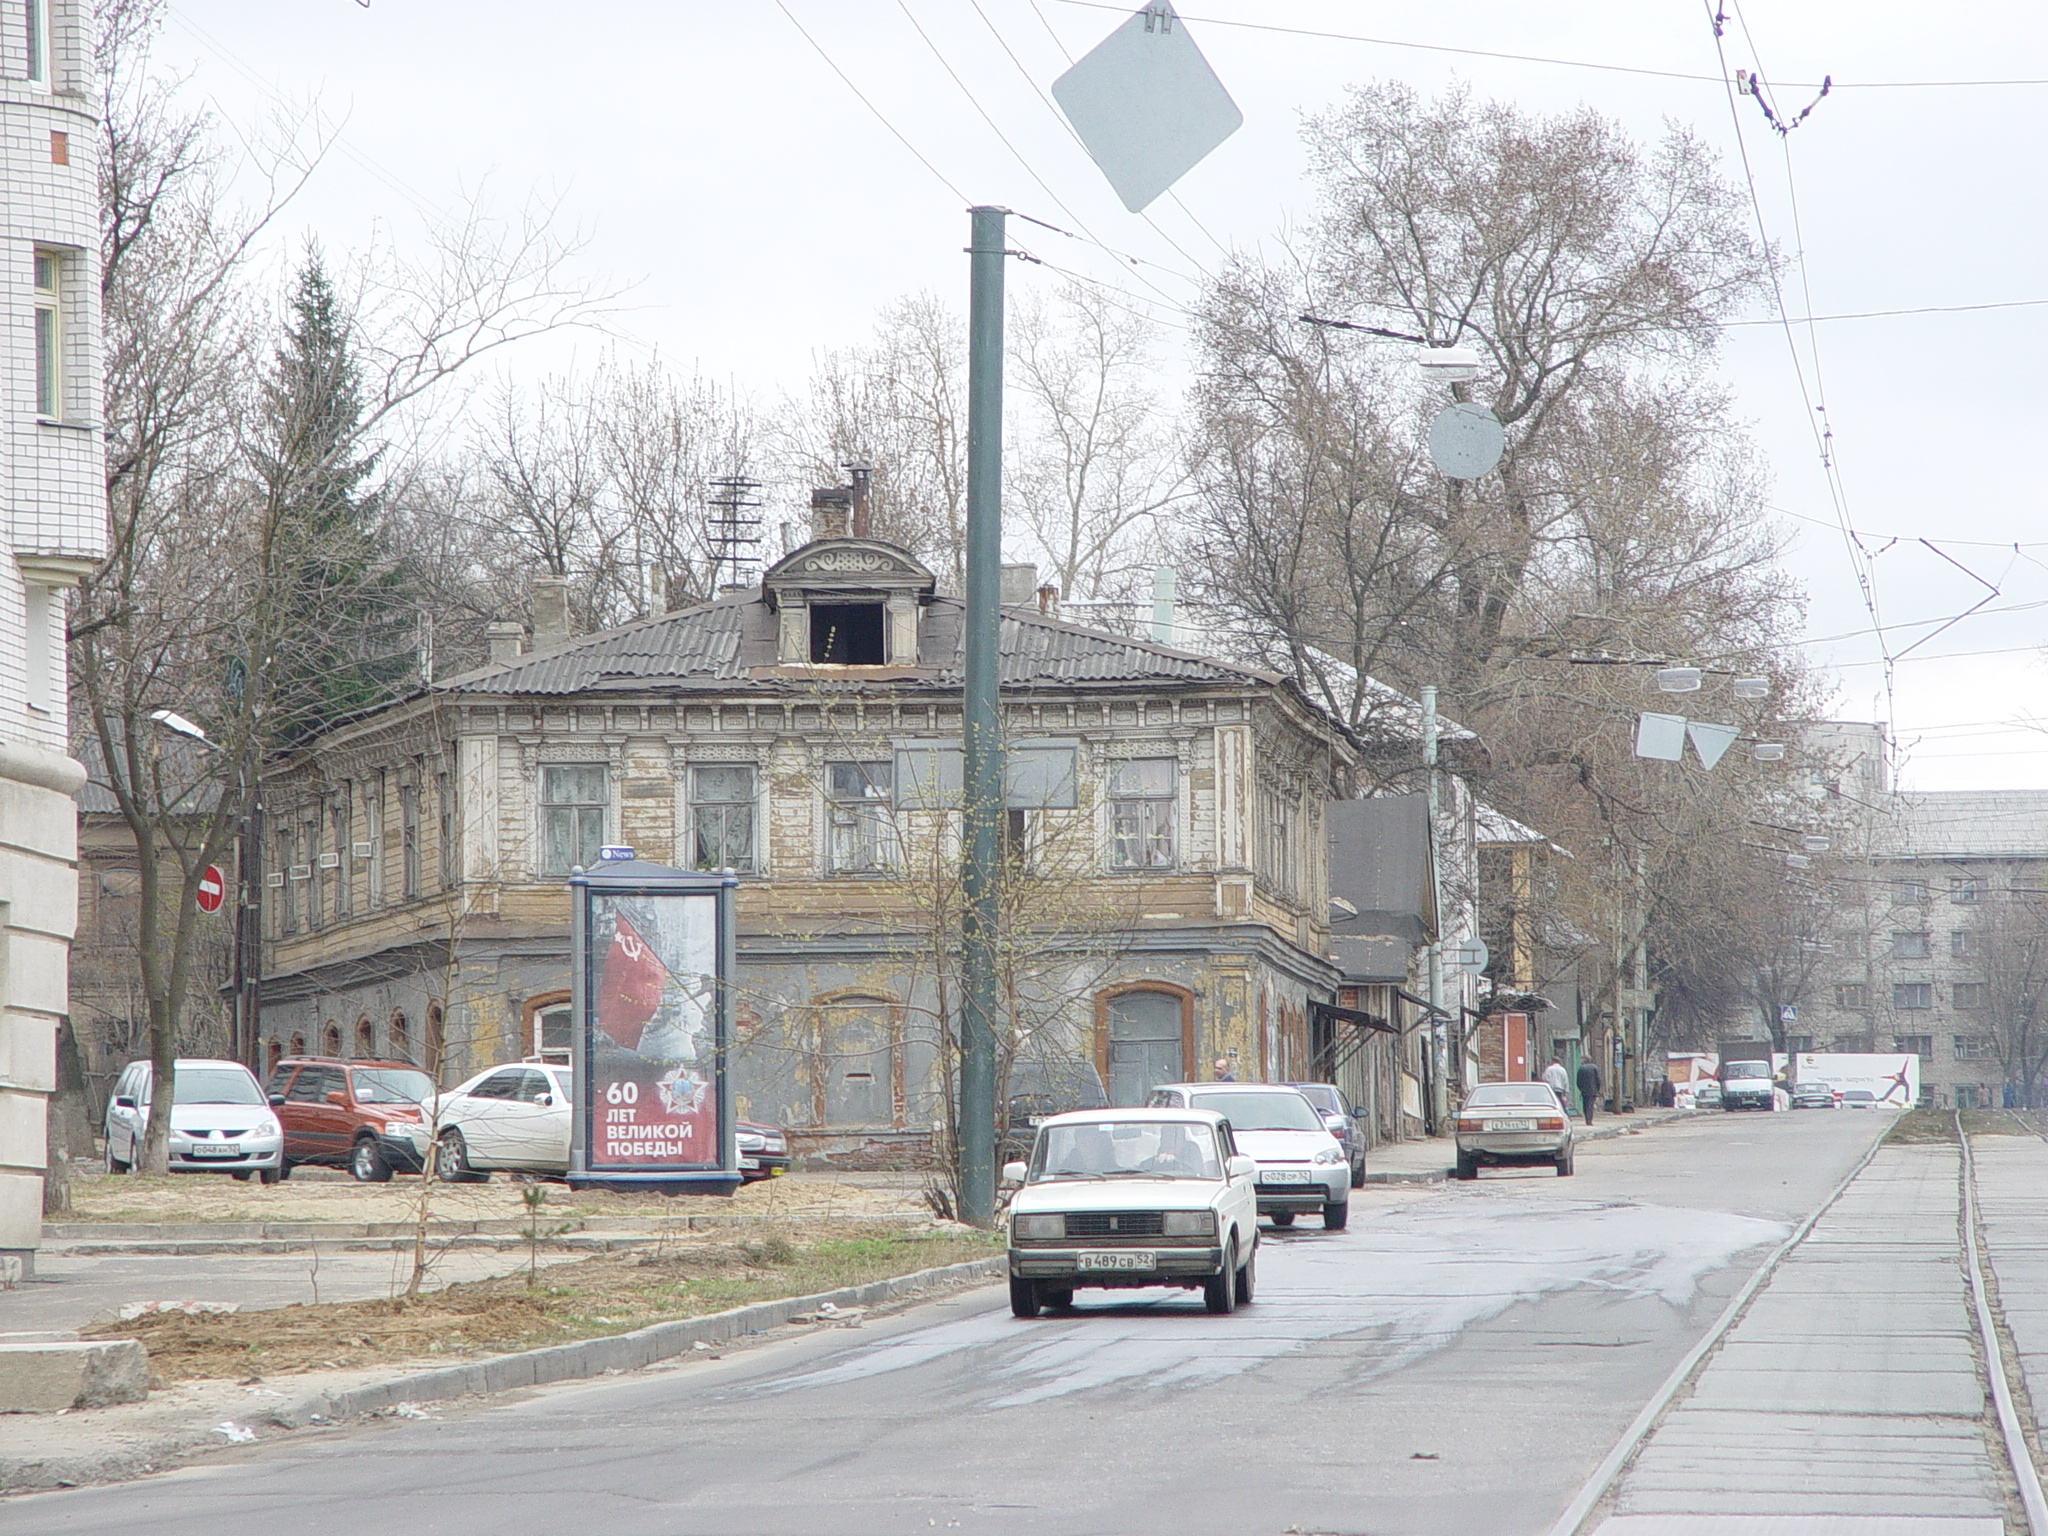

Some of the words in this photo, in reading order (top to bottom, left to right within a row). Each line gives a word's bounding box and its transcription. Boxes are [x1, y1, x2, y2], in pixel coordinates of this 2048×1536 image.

[606, 1081, 639, 1105] 60
[605, 1108, 637, 1123] ЛЕТ
[606, 1120, 693, 1139] ВЕЛИКОЙ
[606, 1140, 683, 1158] ПОБЕДЫ
